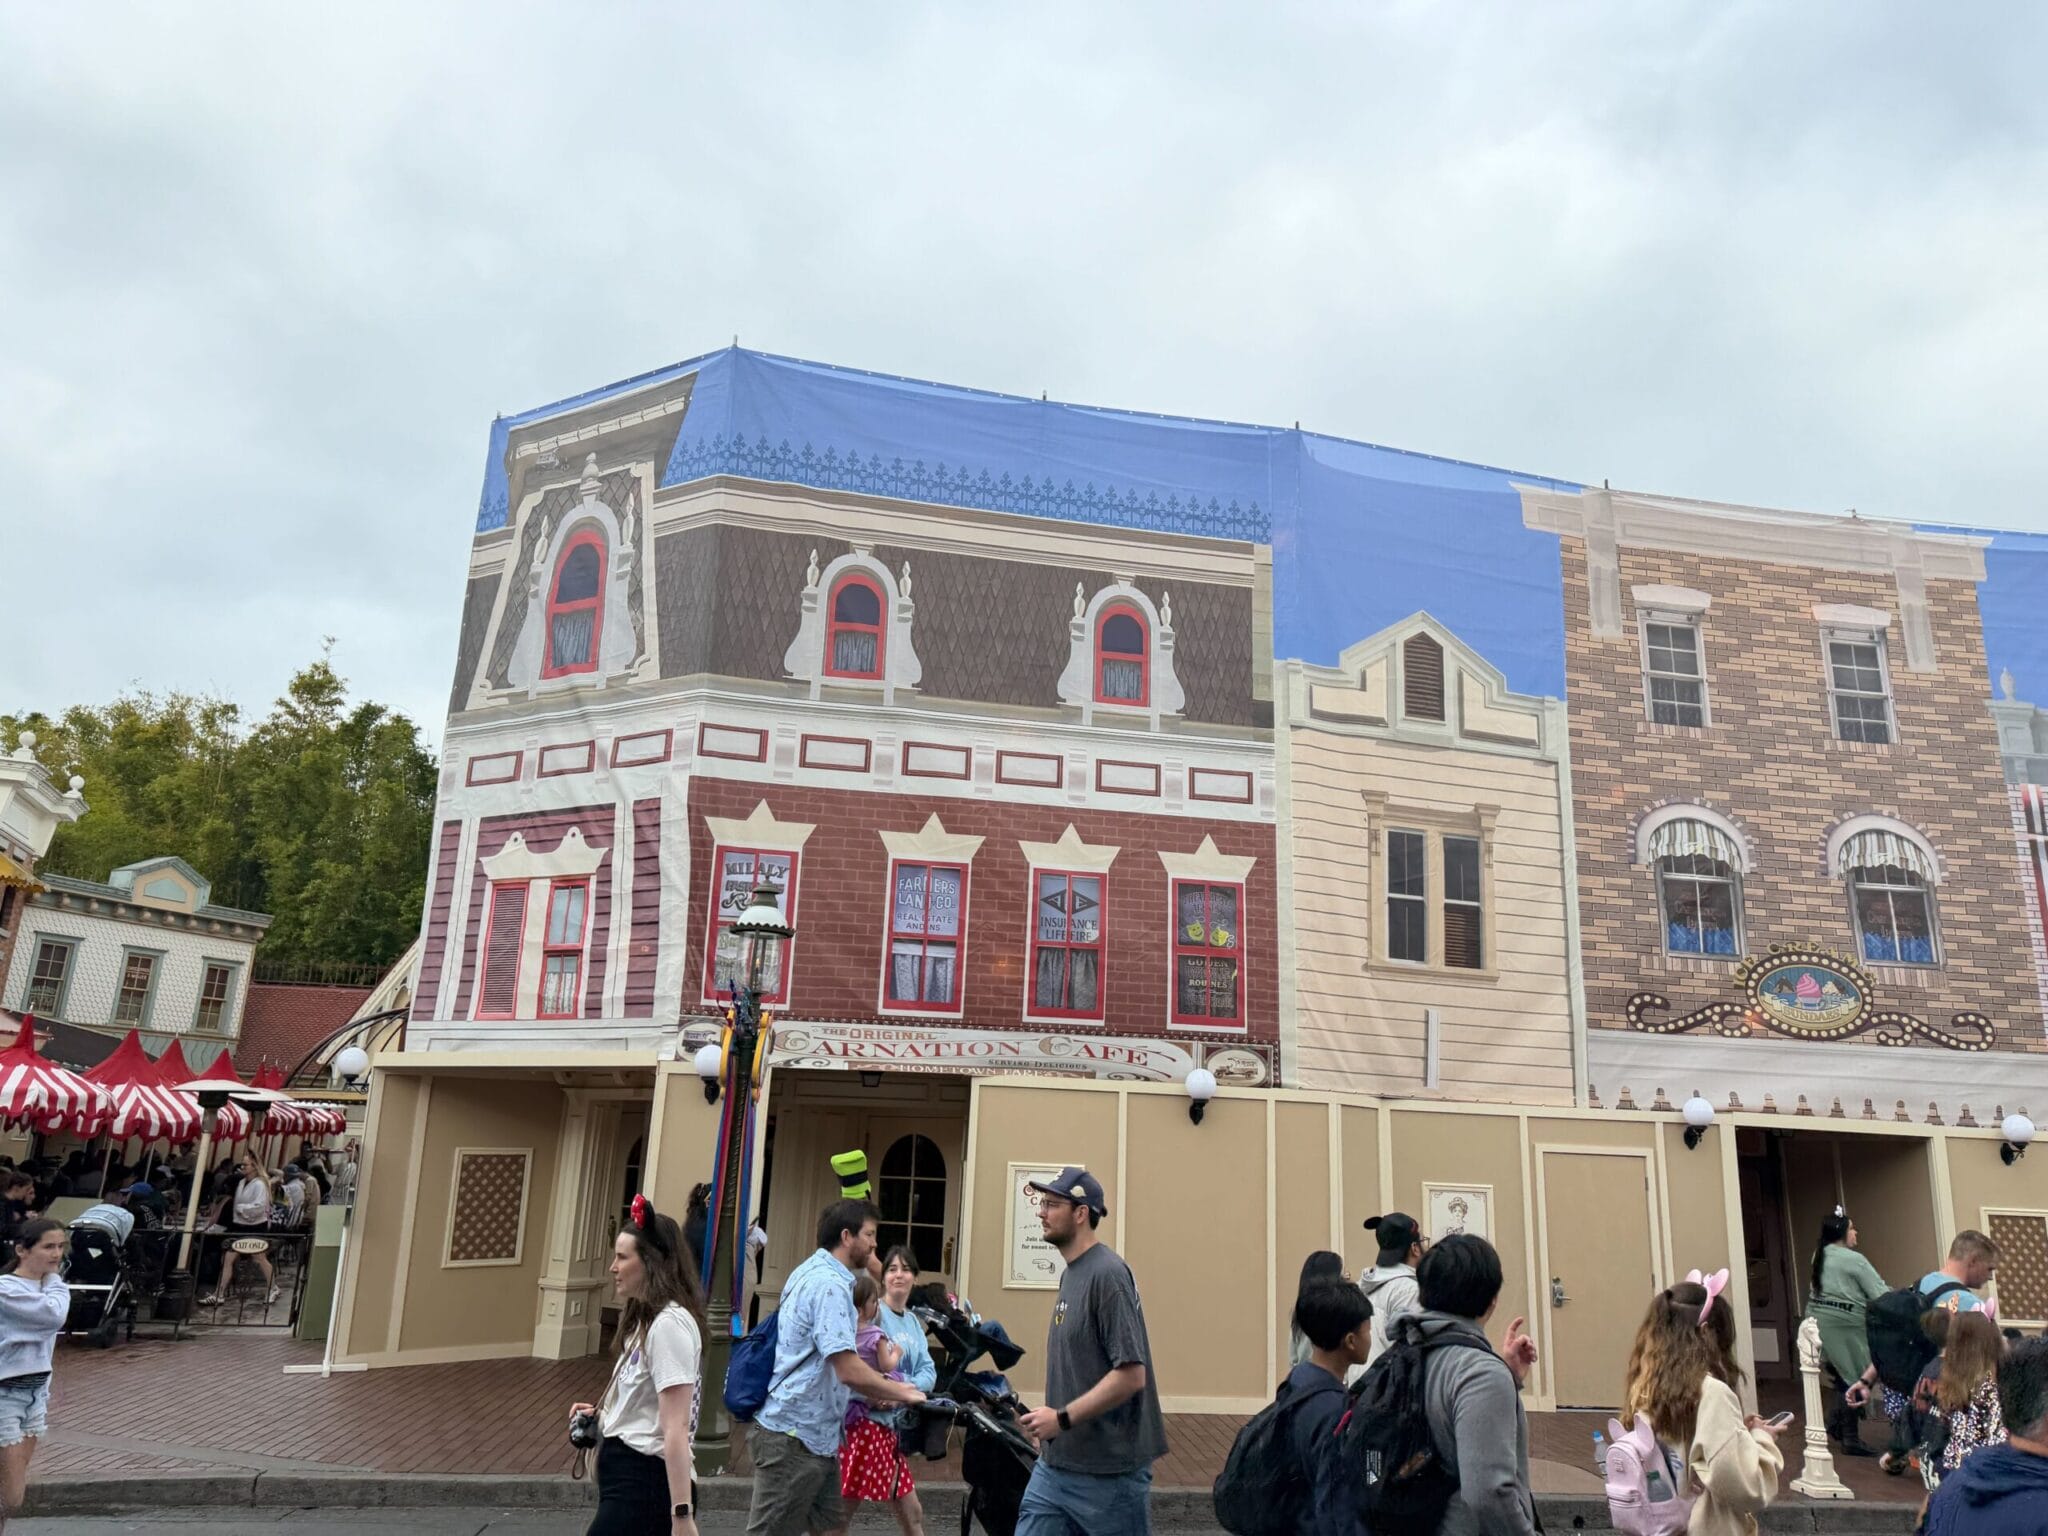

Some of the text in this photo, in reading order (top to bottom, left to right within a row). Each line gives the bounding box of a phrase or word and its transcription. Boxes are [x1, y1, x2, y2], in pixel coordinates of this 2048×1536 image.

[1040, 916, 1098, 930] INSUANCE
[1045, 928, 1092, 942] LIFE FIRE
[823, 1027, 938, 1040] THE ORIGINAL
[774, 1030, 1021, 1057] CARNATION
[1034, 1060, 1088, 1070] DELICIOUS
